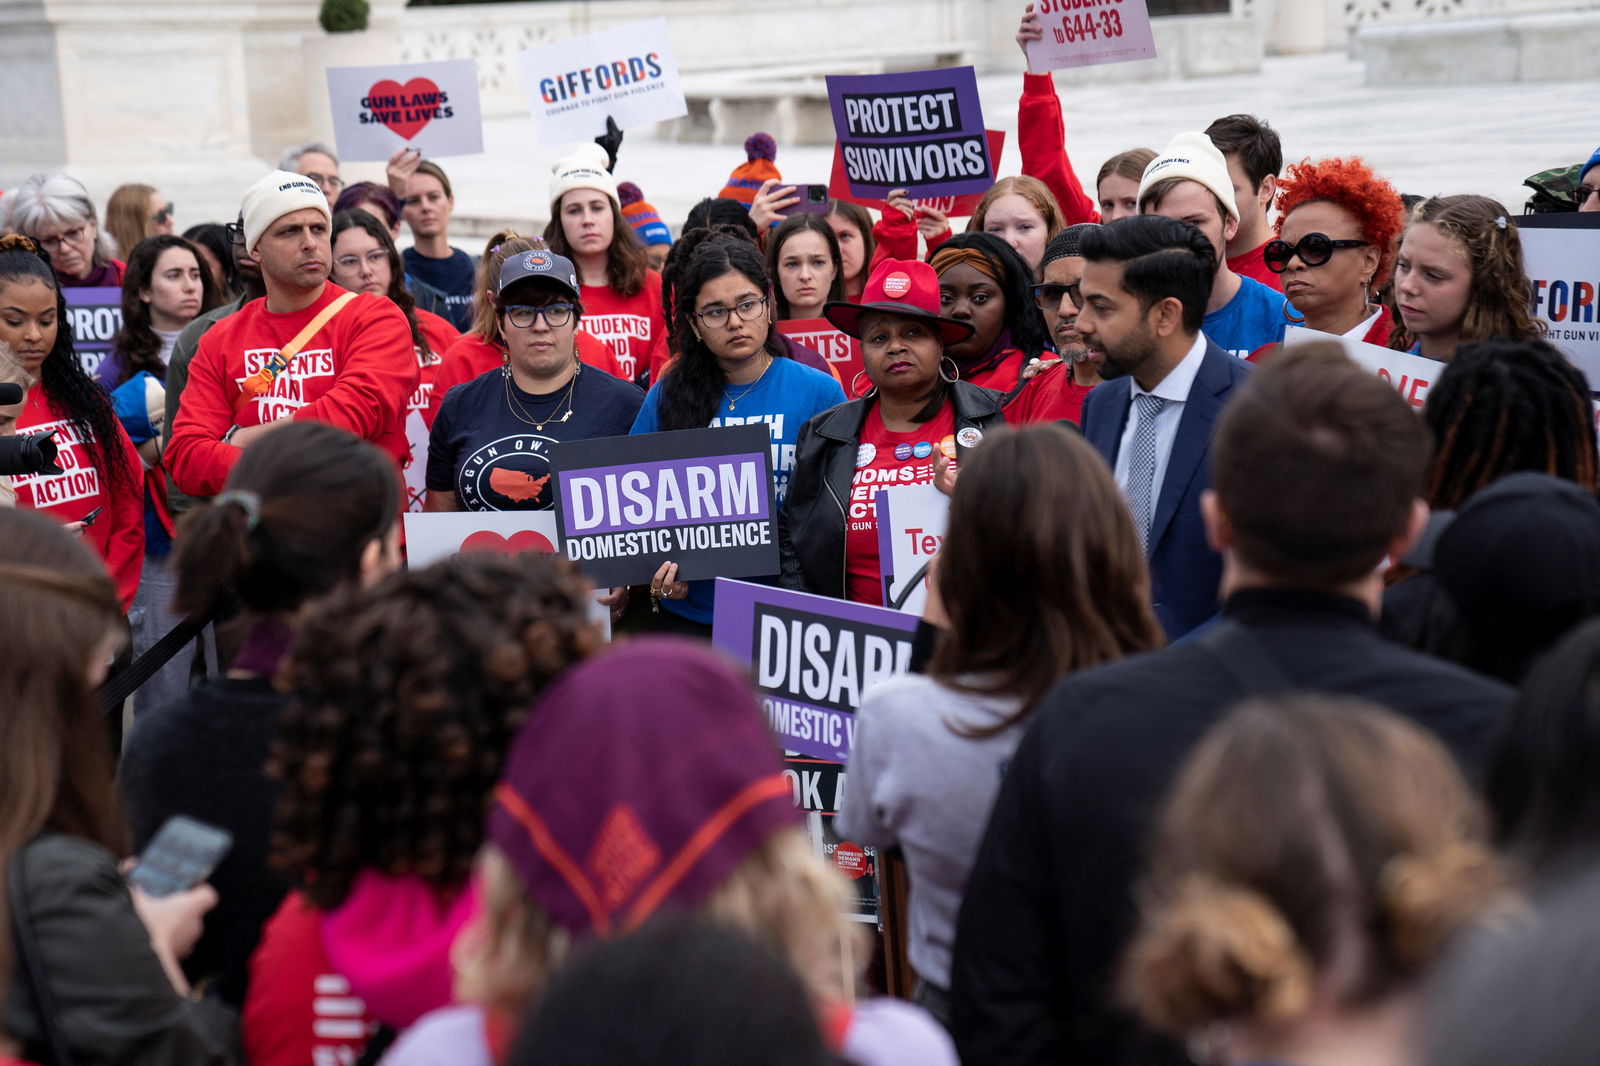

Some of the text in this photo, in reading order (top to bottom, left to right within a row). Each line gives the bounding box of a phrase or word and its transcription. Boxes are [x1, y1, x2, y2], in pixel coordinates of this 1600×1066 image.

[1053, 9, 1123, 44] to 644-33
[540, 52, 662, 104] GIFFORDS
[359, 106, 454, 124] SAVE LIVES
[360, 91, 449, 109] GUN LAWS
[546, 82, 665, 116] COURAGE TO FIGHT GUN VIOLENCE
[845, 92, 954, 134] PROTECT
[844, 140, 985, 183] SURVIVORS
[1563, 330, 1586, 341] GUN
[246, 352, 334, 375] STENTS
[464, 447, 498, 478] GUN
[35, 470, 97, 505] ACTION
[569, 461, 760, 530] DISARM
[566, 529, 672, 561] DOMESTIC
[675, 521, 771, 551] VIOLENCE
[852, 522, 872, 531] GUN
